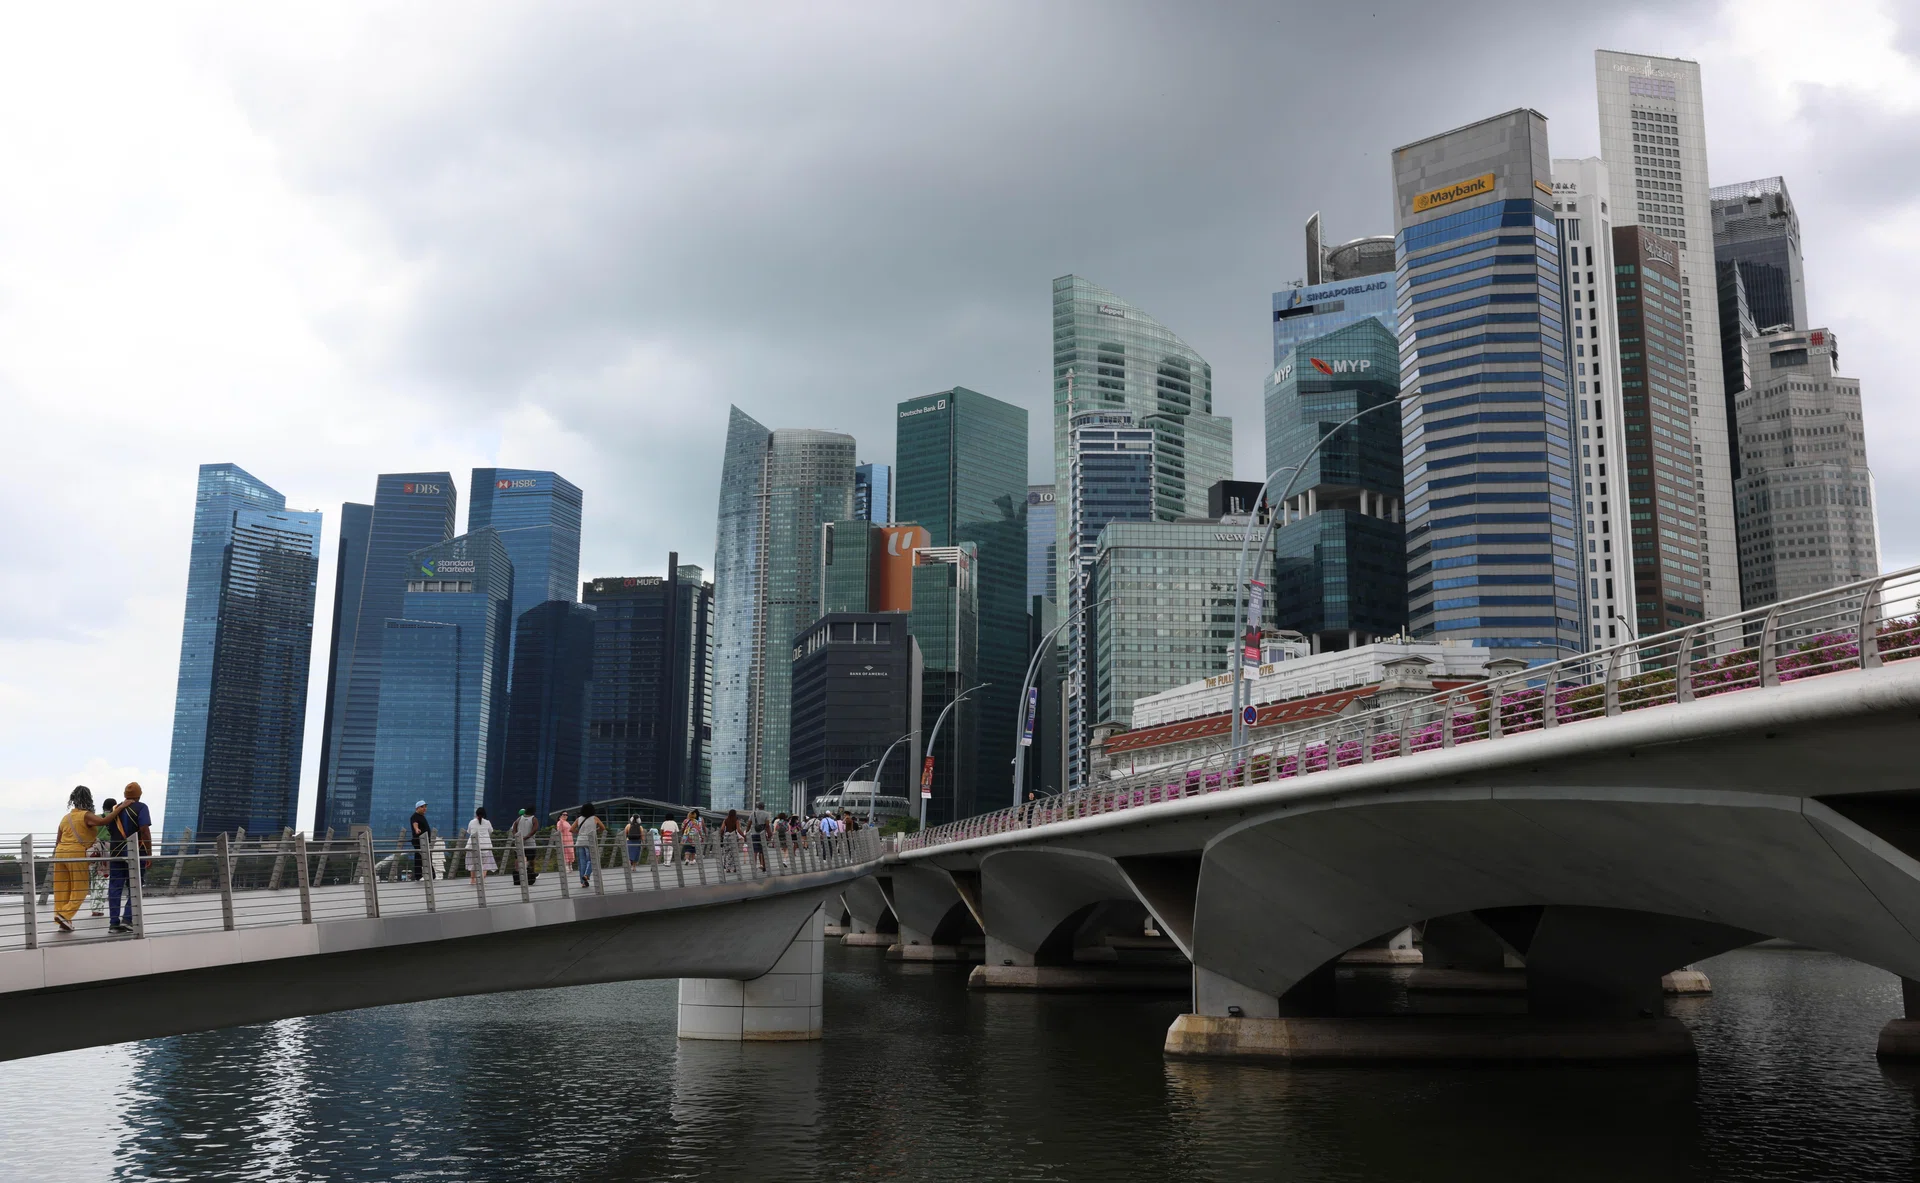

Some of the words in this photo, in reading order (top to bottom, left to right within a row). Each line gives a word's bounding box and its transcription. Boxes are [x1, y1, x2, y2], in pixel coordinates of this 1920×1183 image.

[1430, 179, 1485, 204] Maybank
[1100, 305, 1123, 316] Keppel
[1808, 346, 1829, 356] UOB
[1333, 359, 1371, 373] MYP
[1274, 364, 1292, 385] MYP
[900, 408, 923, 418] Deutsche
[923, 405, 937, 413] Bank
[415, 483, 440, 494] DBS
[511, 479, 537, 488] HSBC
[1214, 530, 1264, 542] wewrk
[1205, 677, 1217, 689] THE
[1259, 664, 1275, 676] OTEL
